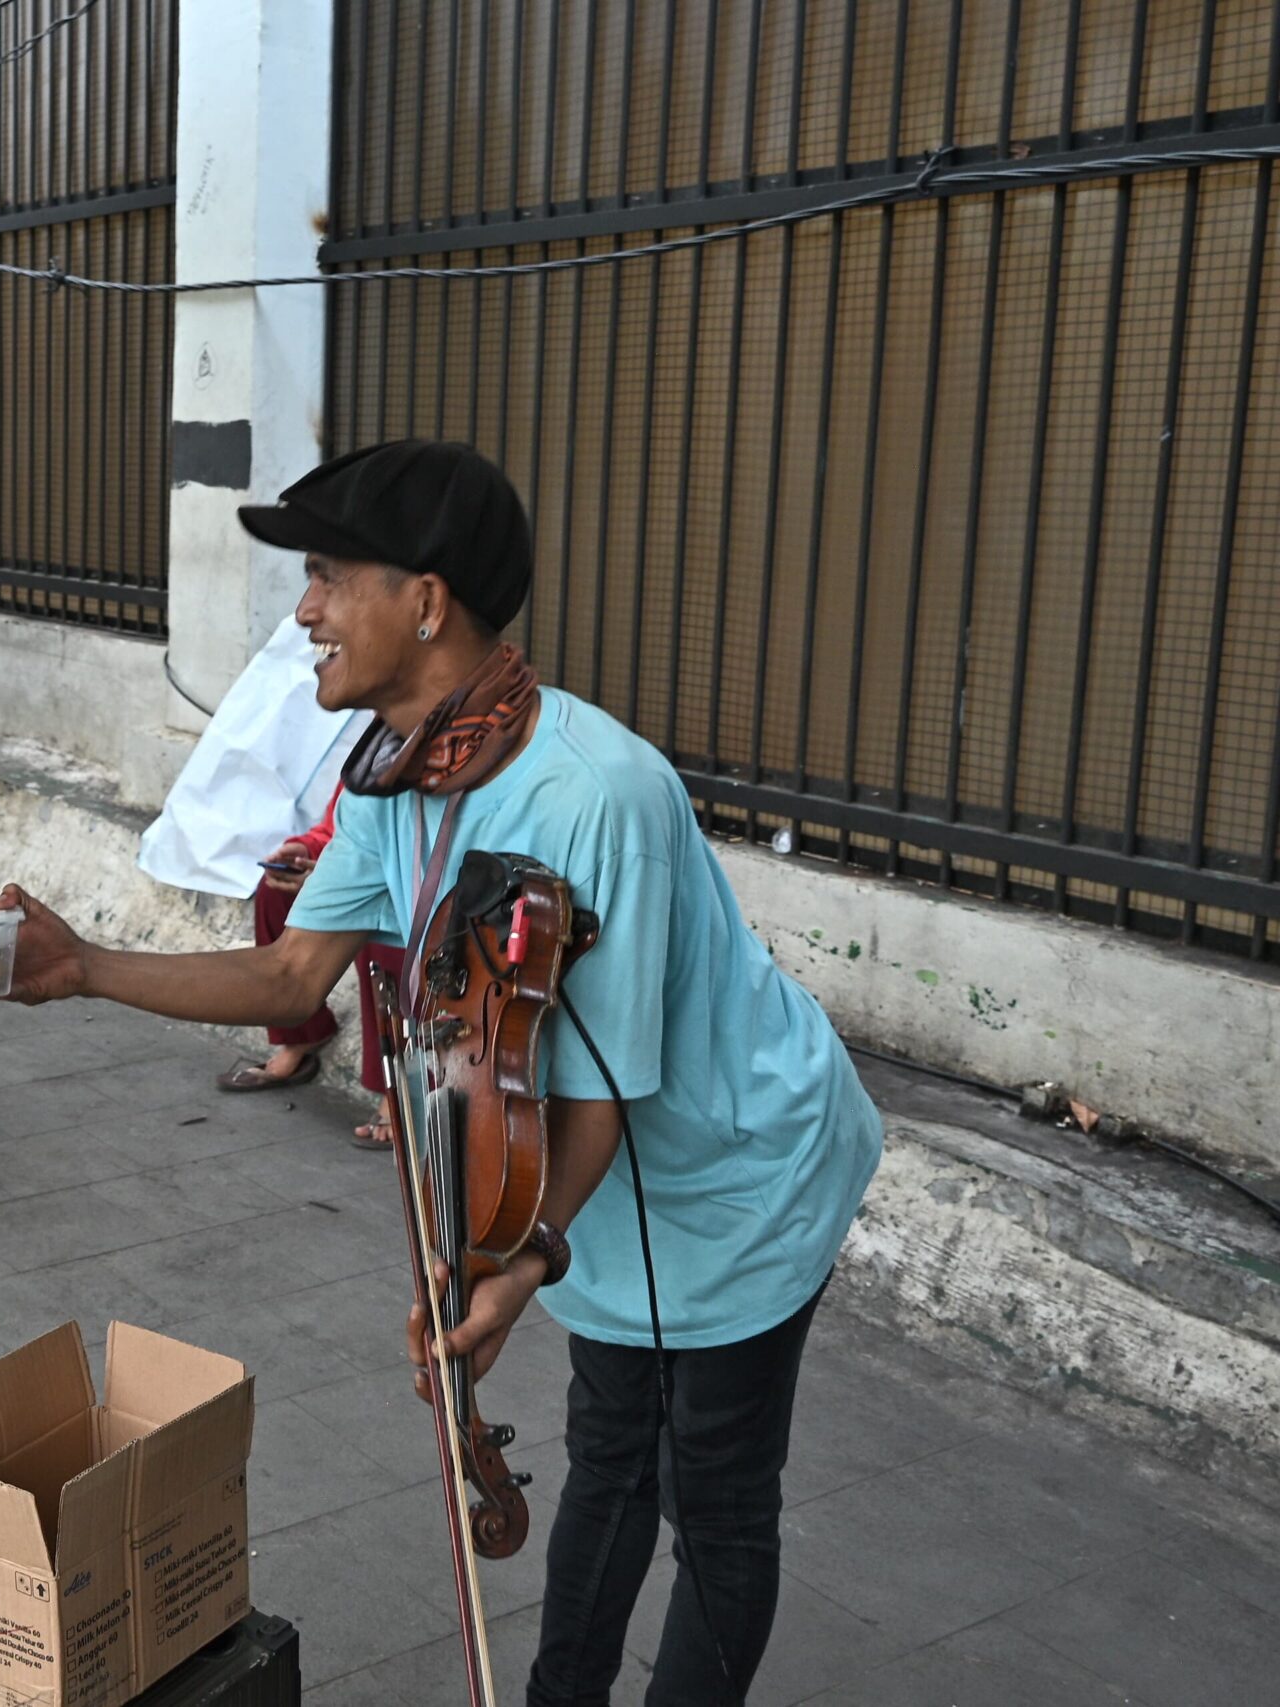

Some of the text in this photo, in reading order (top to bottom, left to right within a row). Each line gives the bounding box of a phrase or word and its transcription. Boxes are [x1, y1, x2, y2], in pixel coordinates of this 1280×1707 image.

[144, 1543, 173, 1571] STICK
[76, 1598, 121, 1633] Choconado
[77, 1630, 94, 1650] Milk
[96, 1615, 120, 1636] Melon
[78, 1641, 107, 1667] Anggur
